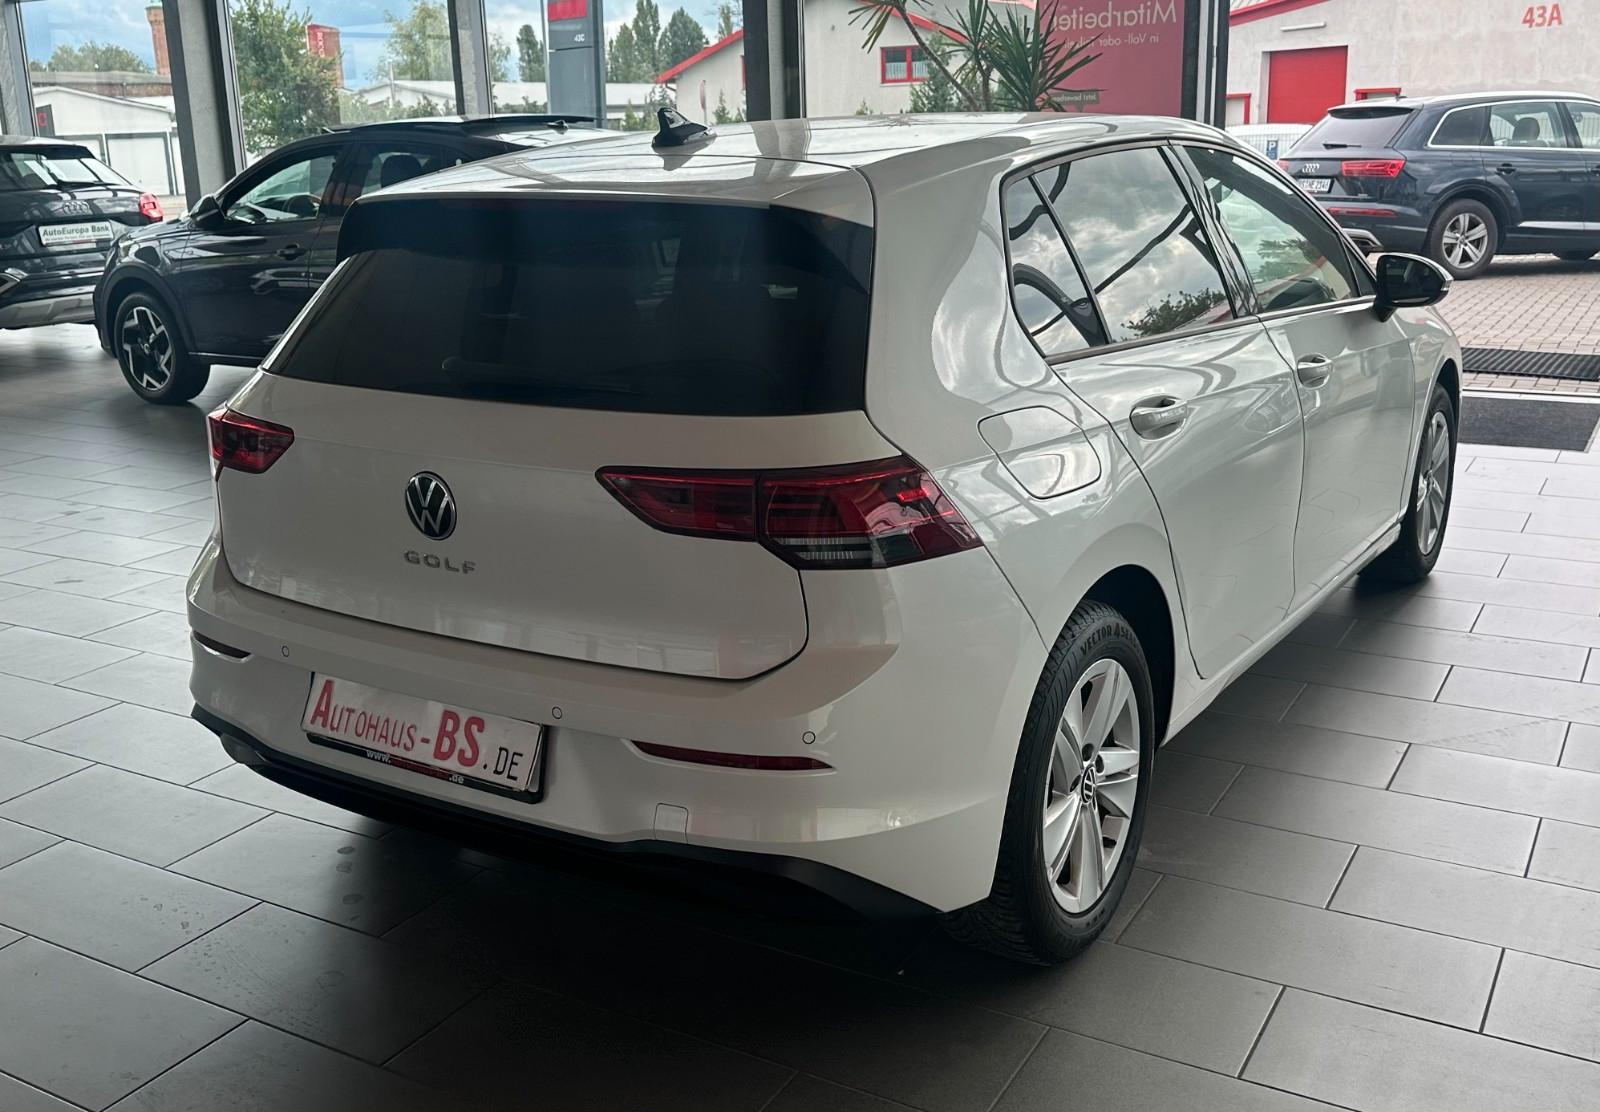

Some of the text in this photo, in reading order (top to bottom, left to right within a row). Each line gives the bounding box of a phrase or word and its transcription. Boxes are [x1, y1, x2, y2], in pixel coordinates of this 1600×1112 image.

[1521, 3, 1563, 28] 43A
[42, 225, 109, 237] AutoEuropa Bank
[404, 549, 476, 574] GOLF
